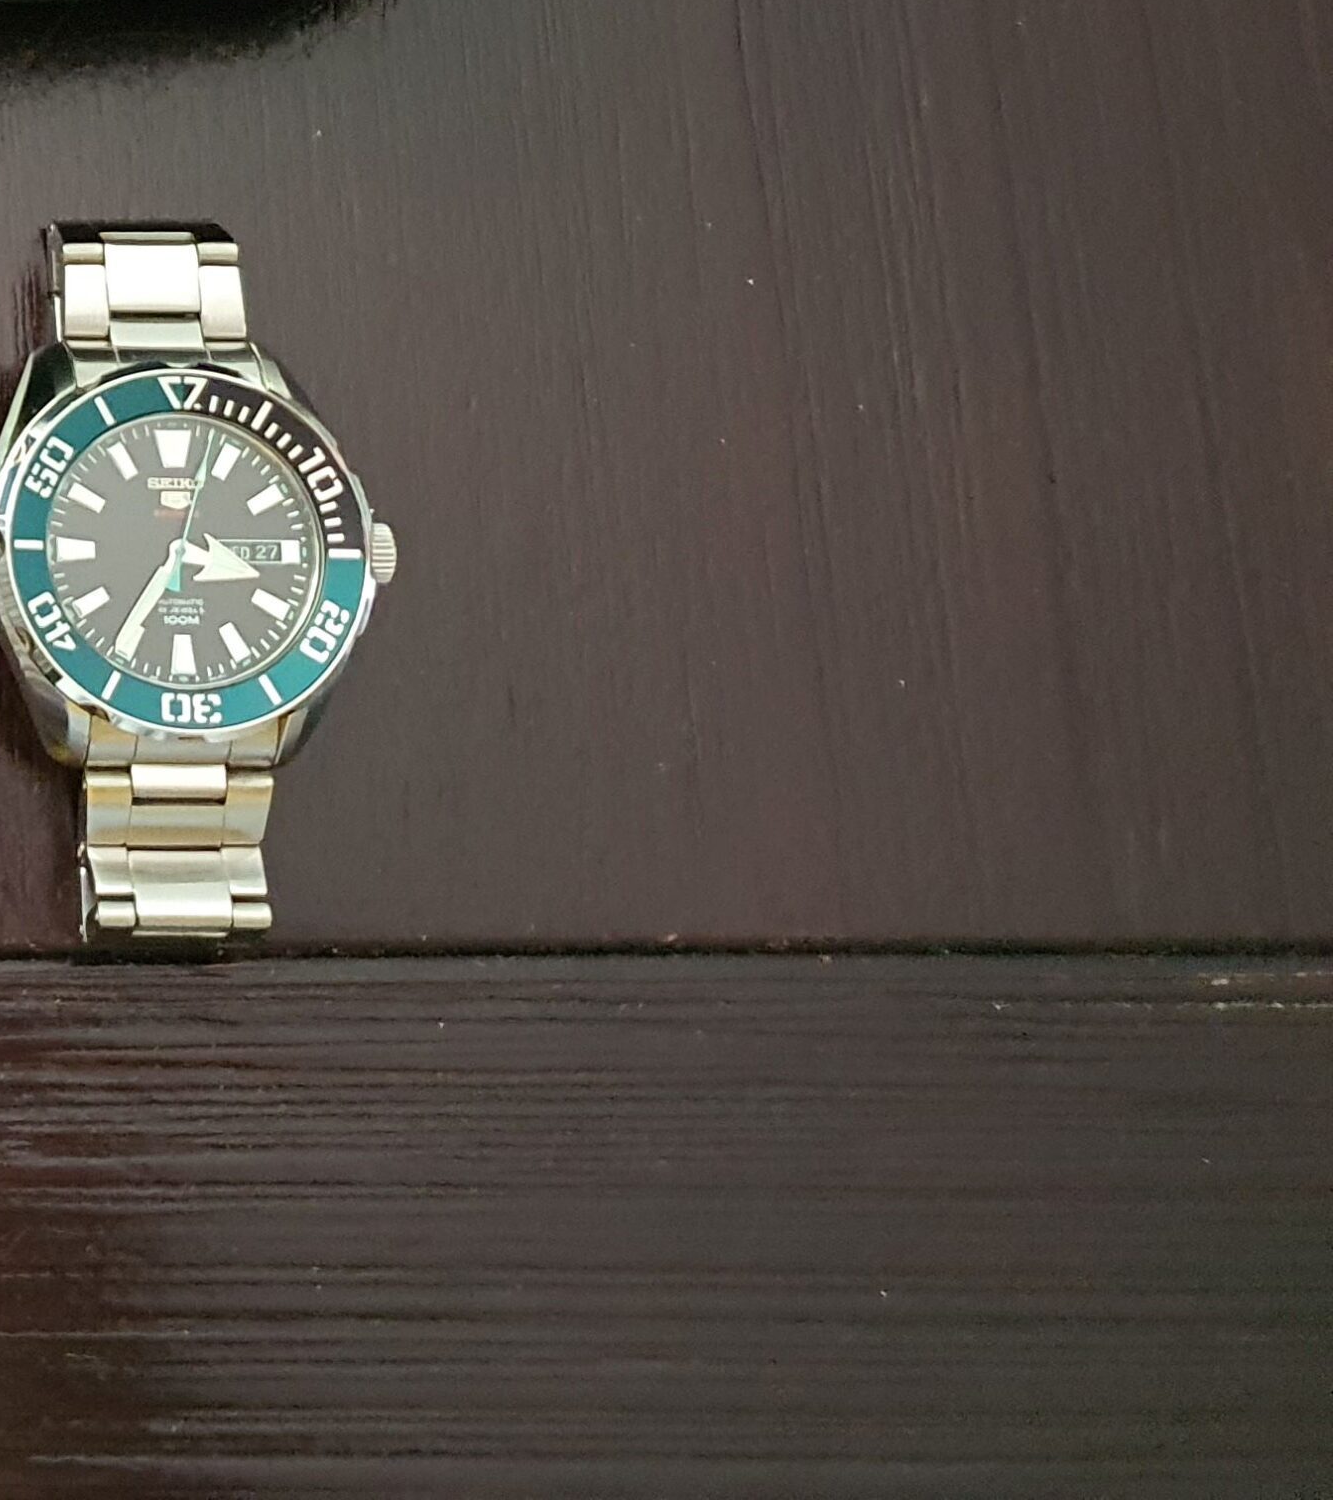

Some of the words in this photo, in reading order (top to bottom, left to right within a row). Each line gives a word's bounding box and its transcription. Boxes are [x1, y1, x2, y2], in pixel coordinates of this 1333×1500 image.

[24, 436, 74, 498] 50
[298, 446, 343, 502] 10
[254, 545, 278, 560] 27
[27, 591, 76, 651] 40
[299, 600, 350, 664] 20
[161, 692, 222, 723] 30
